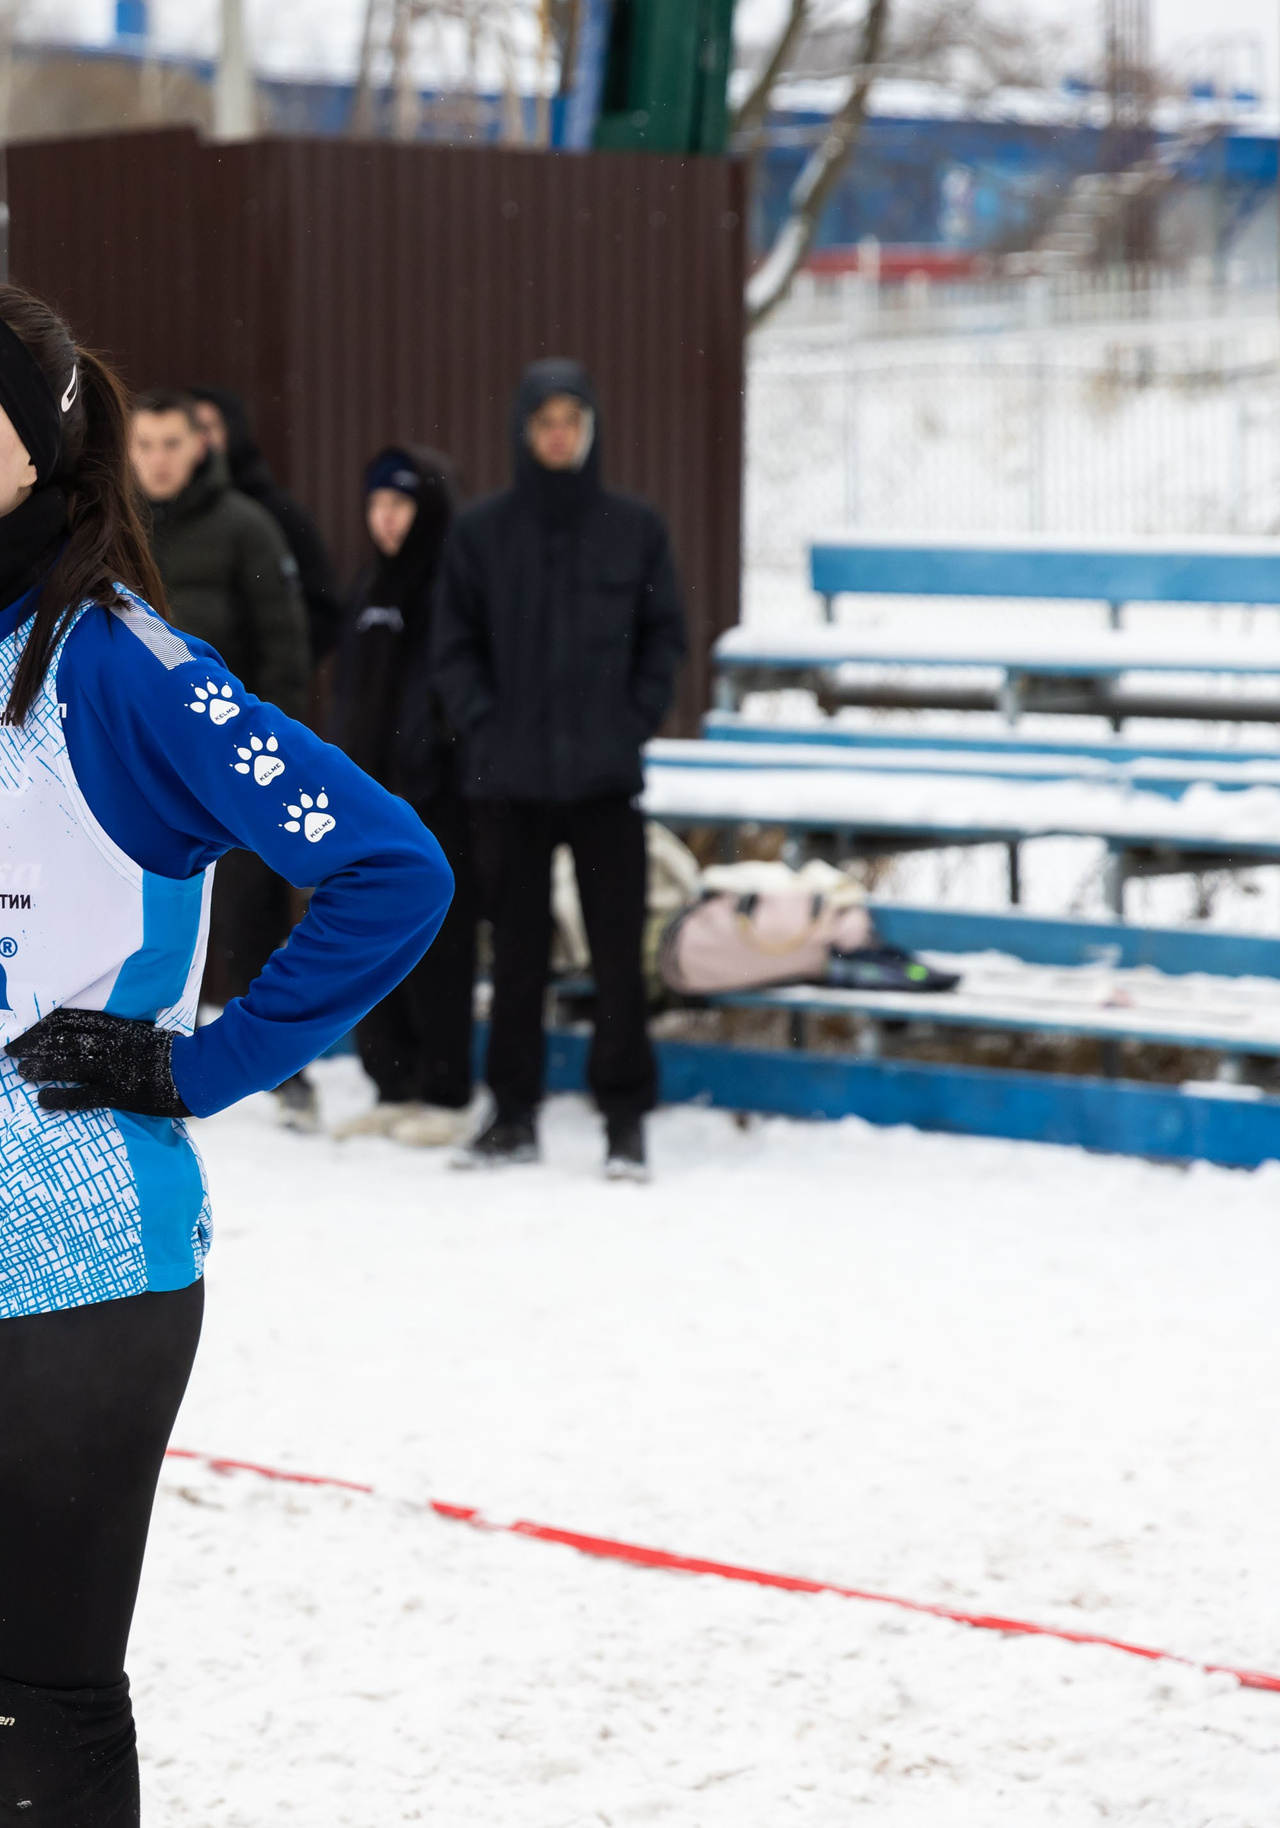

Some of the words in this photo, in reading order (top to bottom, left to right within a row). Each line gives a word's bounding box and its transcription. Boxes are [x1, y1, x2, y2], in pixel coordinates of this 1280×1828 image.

[214, 705, 236, 721] KELME
[259, 762, 282, 782] KELME
[310, 818, 333, 839] KELME
